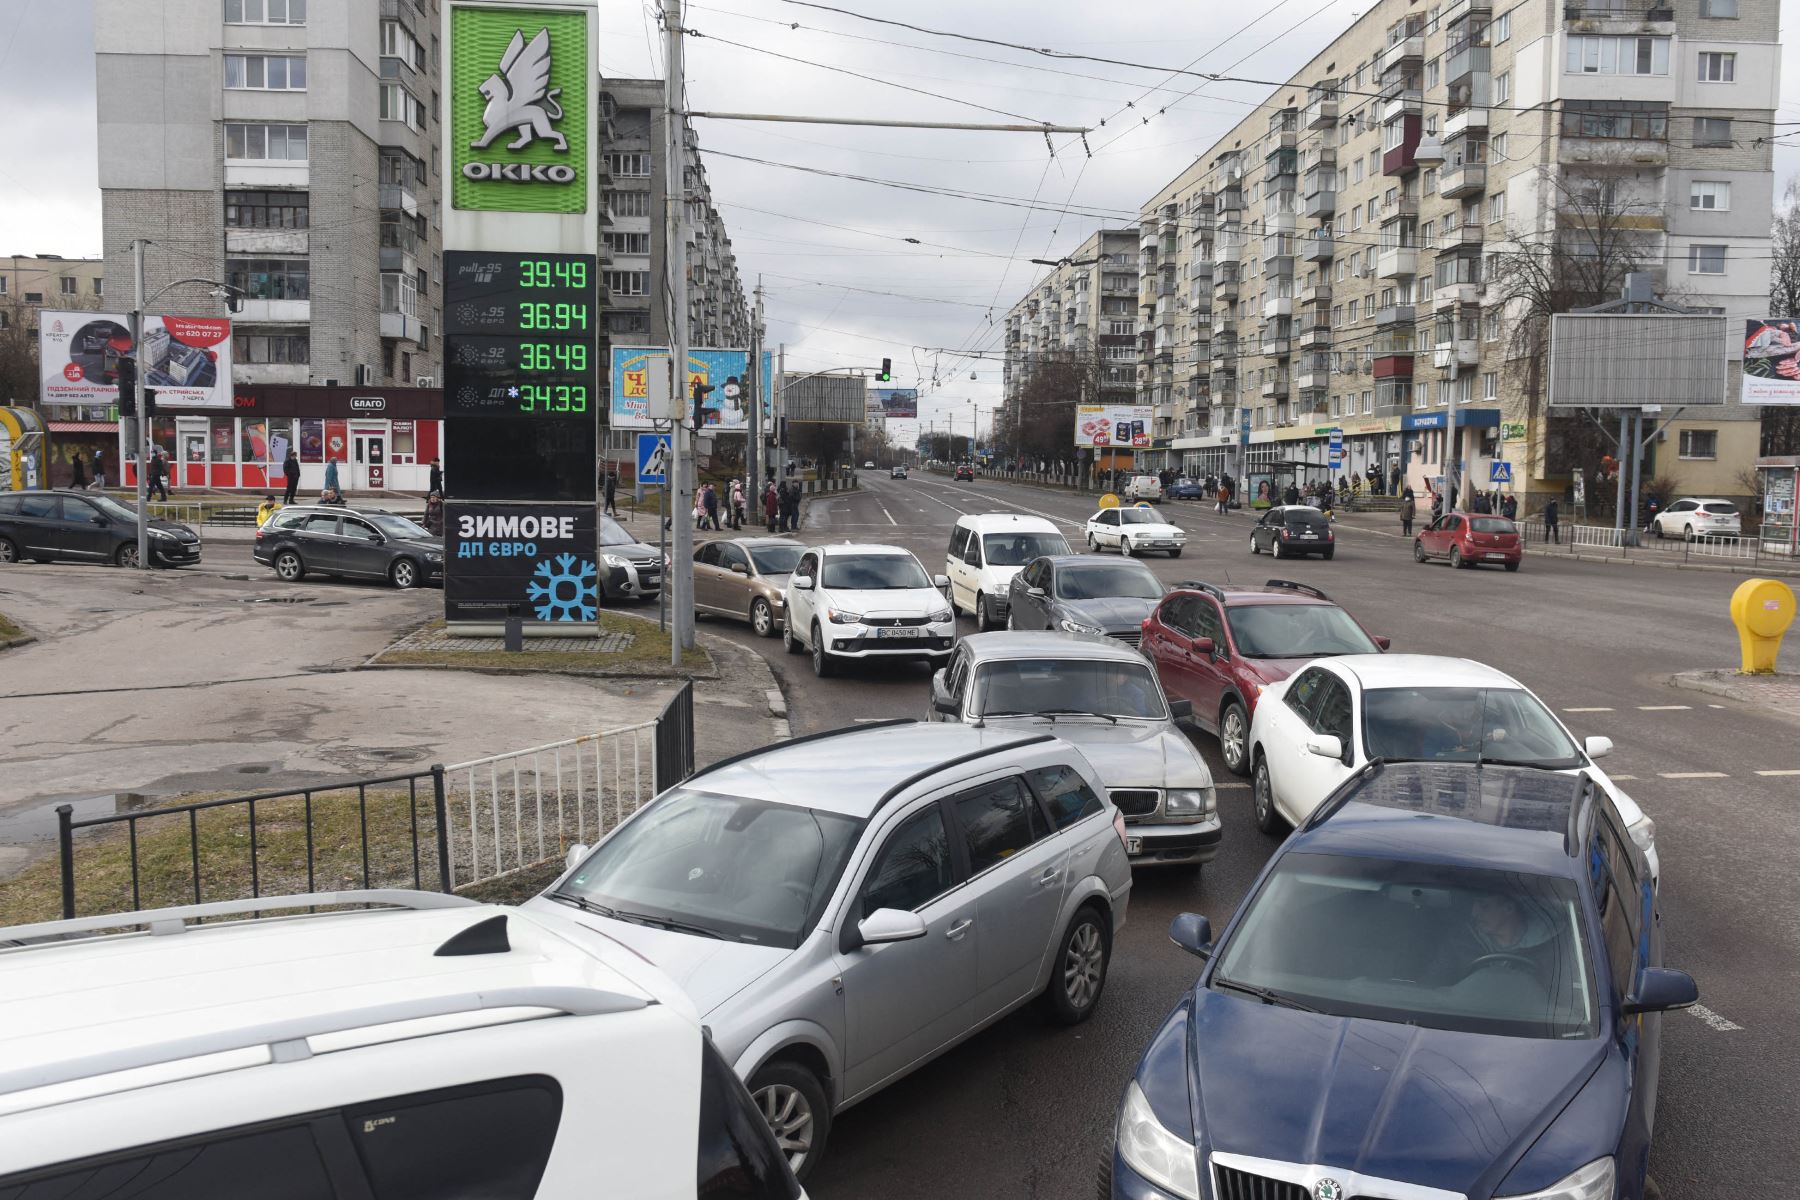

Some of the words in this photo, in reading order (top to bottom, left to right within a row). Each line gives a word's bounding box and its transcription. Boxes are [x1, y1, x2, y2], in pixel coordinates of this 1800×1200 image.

[462, 162, 576, 184] OKKO
[519, 261, 587, 288] 39.49
[519, 303, 587, 330] 36.94
[519, 344, 587, 371] 36.49
[519, 385, 587, 412] 34.33
[458, 515, 574, 539] ЗИМОВЕ
[458, 542, 484, 558] ДП
[489, 542, 537, 557] ЄВРО
